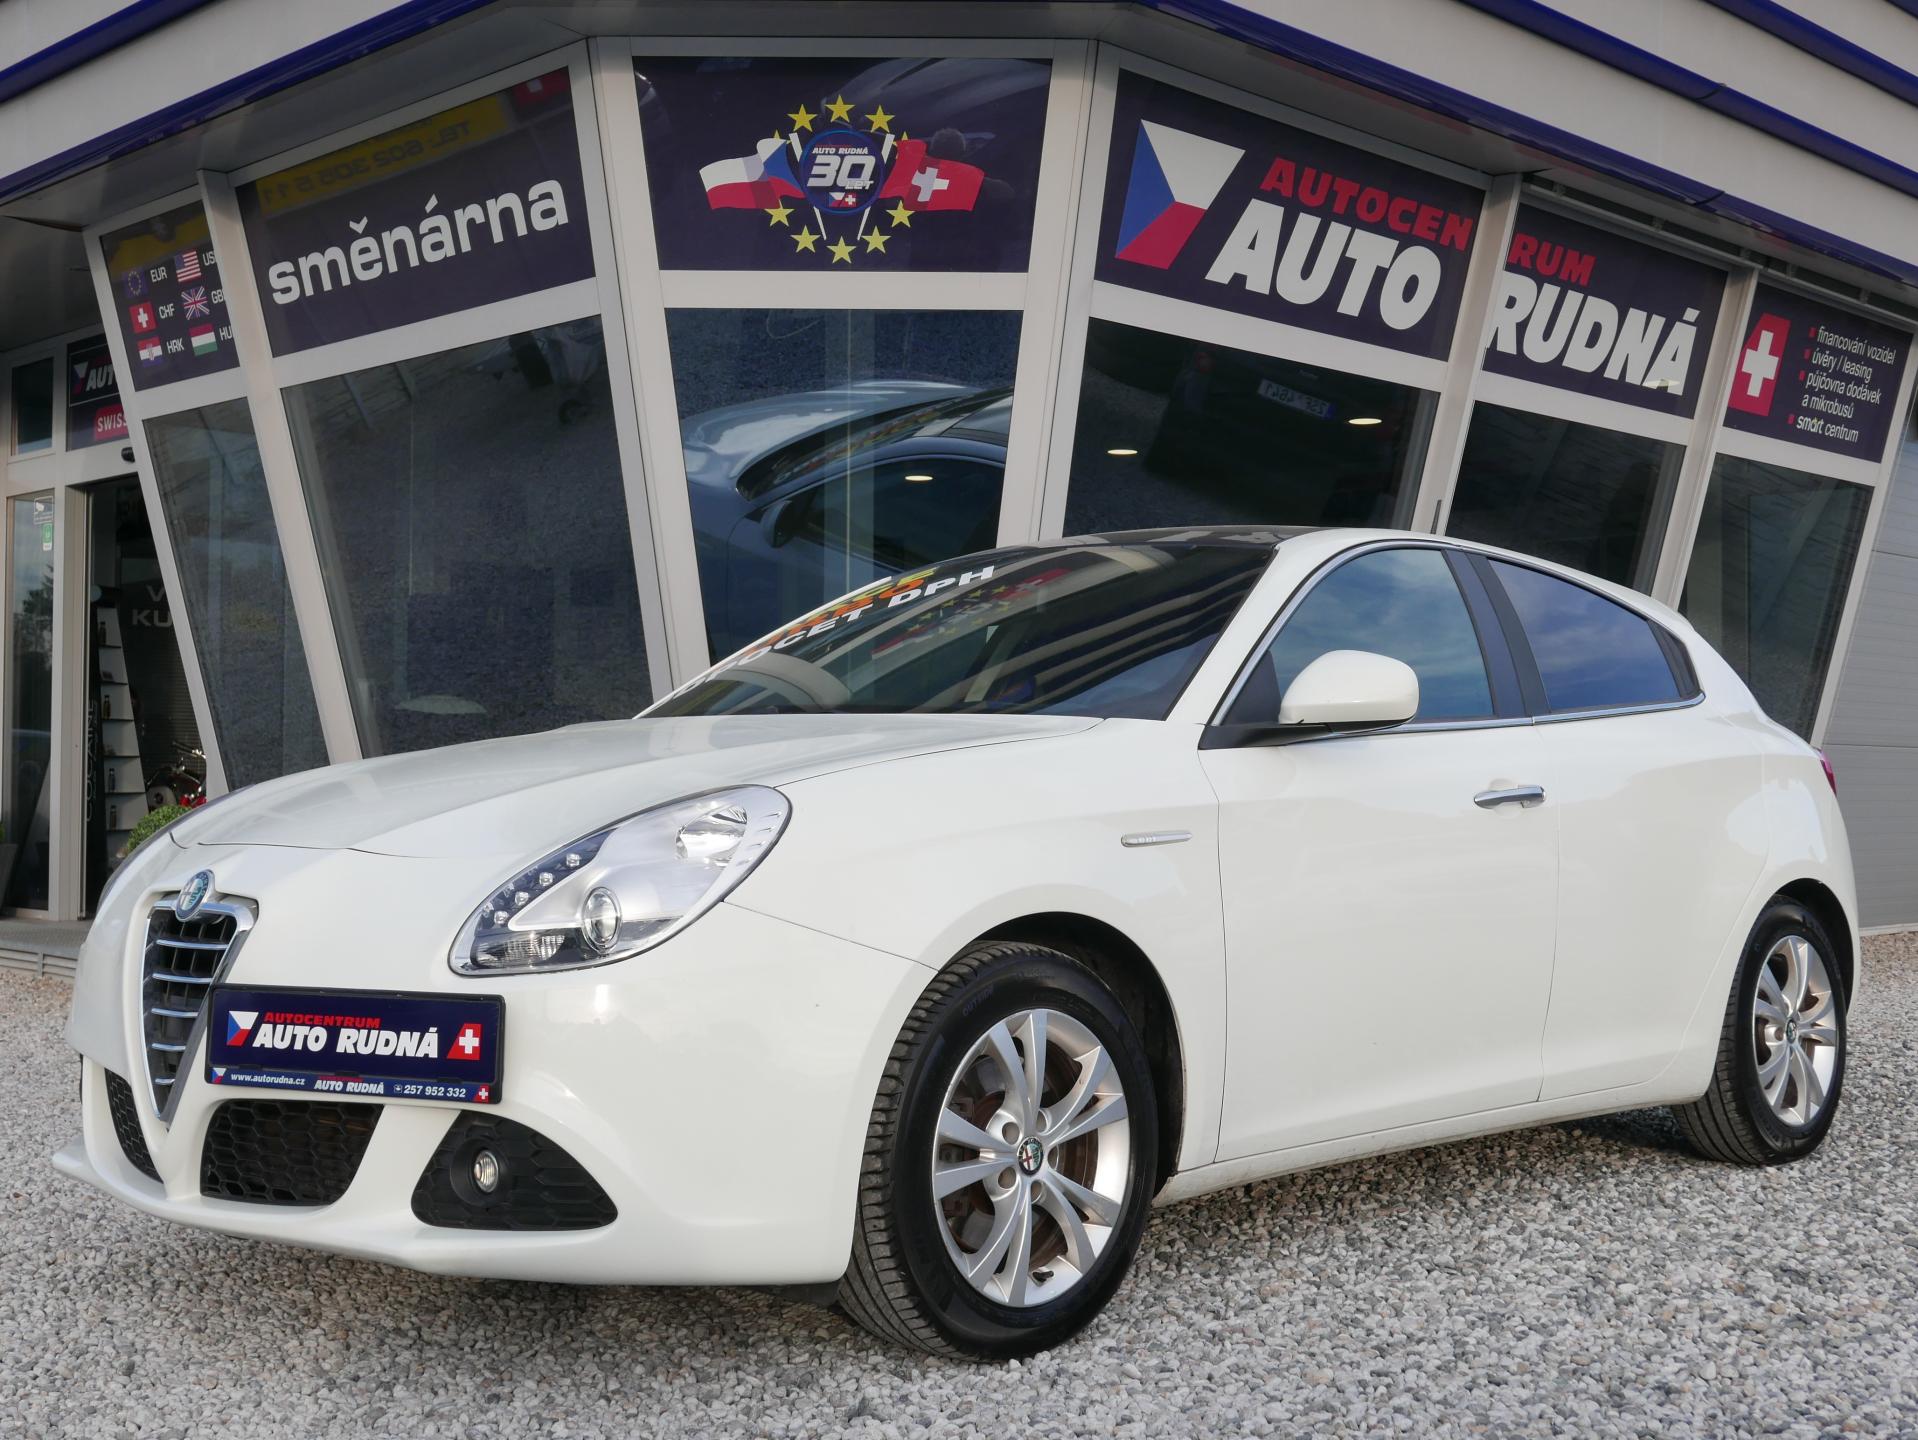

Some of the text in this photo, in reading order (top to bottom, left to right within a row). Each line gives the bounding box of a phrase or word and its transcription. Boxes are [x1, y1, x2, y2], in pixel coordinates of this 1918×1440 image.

[838, 146, 868, 154] RUDNÁ
[807, 154, 876, 187] 30
[845, 181, 874, 190] LET
[268, 179, 570, 306] směnárna
[150, 266, 168, 283] EUR
[1205, 198, 1701, 396] AUTO RUDNÁ
[158, 303, 175, 319] CHF
[166, 337, 185, 354] HRK
[1817, 326, 1897, 366] financování vozidel
[1811, 347, 1838, 373] úvěry
[1841, 356, 1873, 383] leasing
[1802, 394, 1810, 407] a
[1846, 381, 1882, 405] dodávek
[1796, 414, 1859, 443] smart centrum
[887, 565, 996, 607] DPH
[263, 1011, 382, 1029] AUTOCENTRUM
[252, 1023, 439, 1058] AUTO RUDNÁ
[230, 1073, 306, 1086] www.autorudna.cz
[313, 1079, 344, 1092] AUTO
[346, 1082, 385, 1095] RUDNÁ
[403, 1084, 423, 1095] 257
[425, 1086, 445, 1097] 952
[446, 1087, 467, 1098] 332
